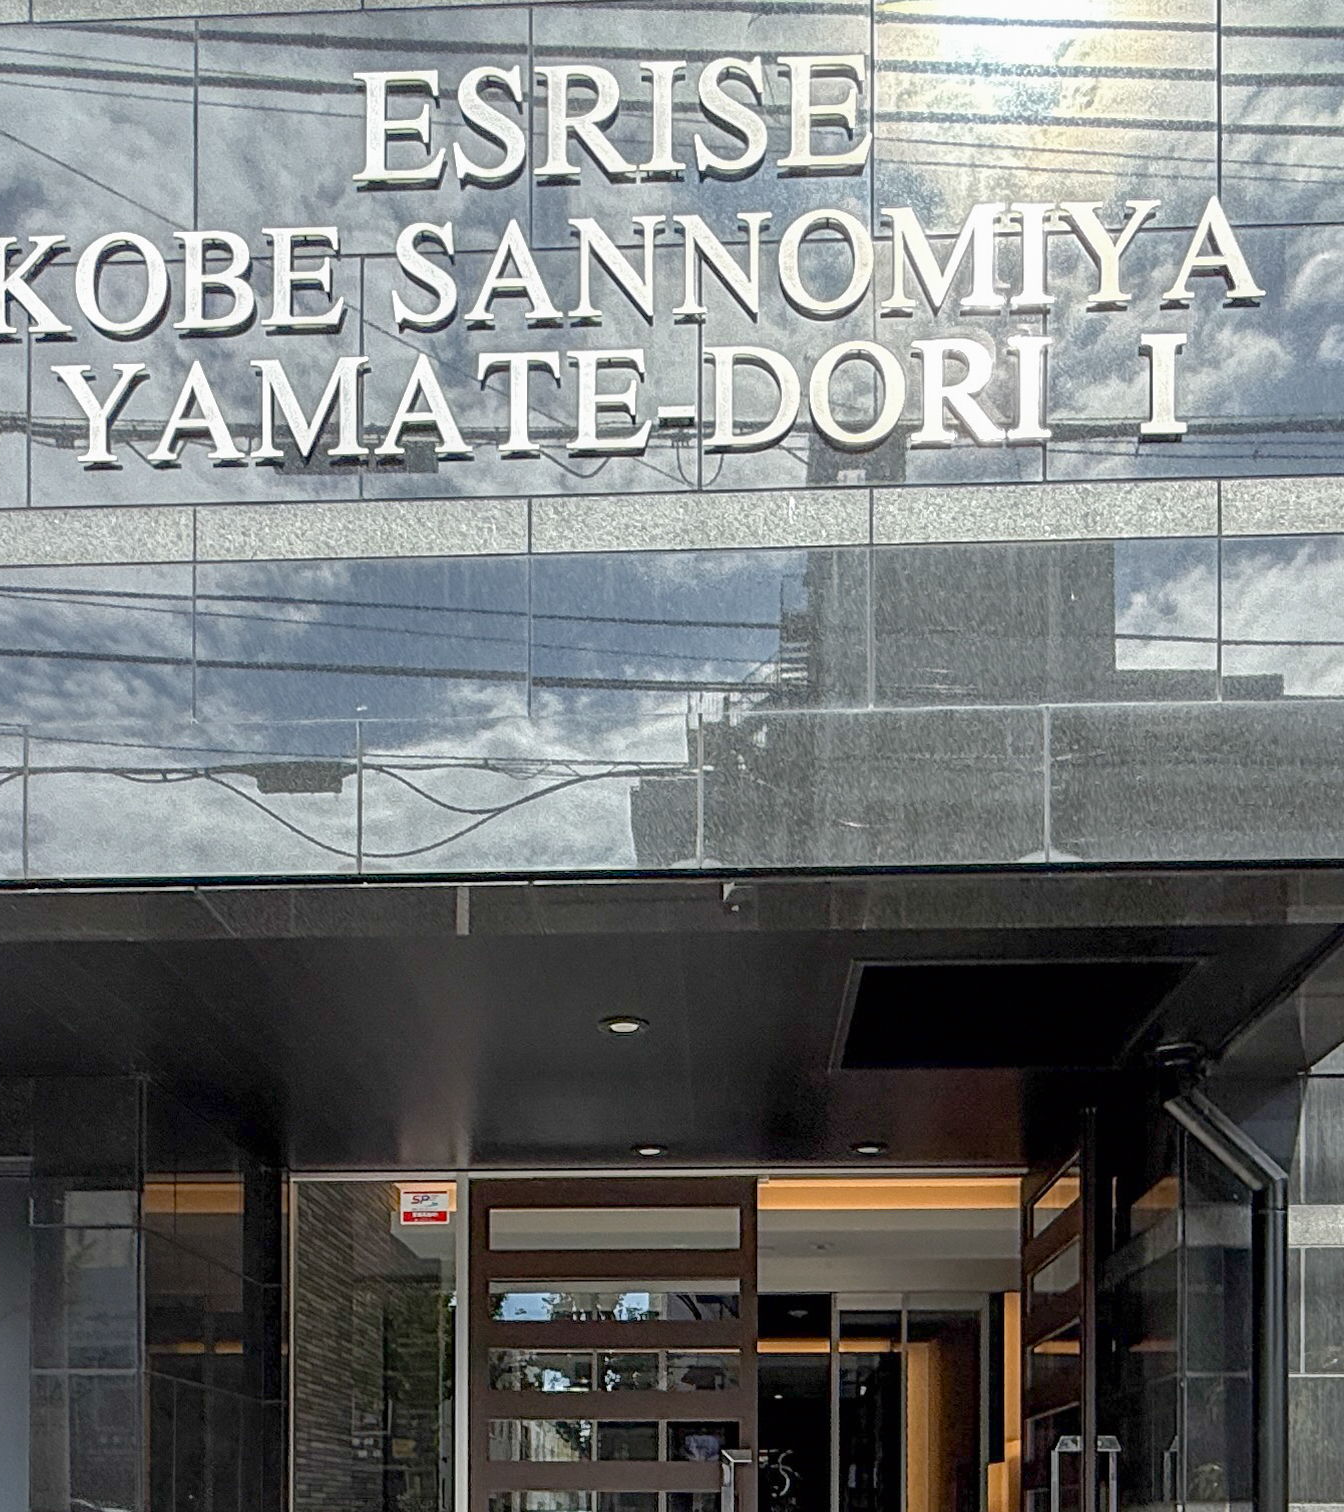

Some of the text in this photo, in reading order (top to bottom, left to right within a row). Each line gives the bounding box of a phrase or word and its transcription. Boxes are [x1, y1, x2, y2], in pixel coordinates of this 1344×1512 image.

[355, 56, 872, 185] ESRISE
[392, 197, 1265, 330] SANNOMIYA
[52, 332, 1185, 465] YAMATE-DORI I
